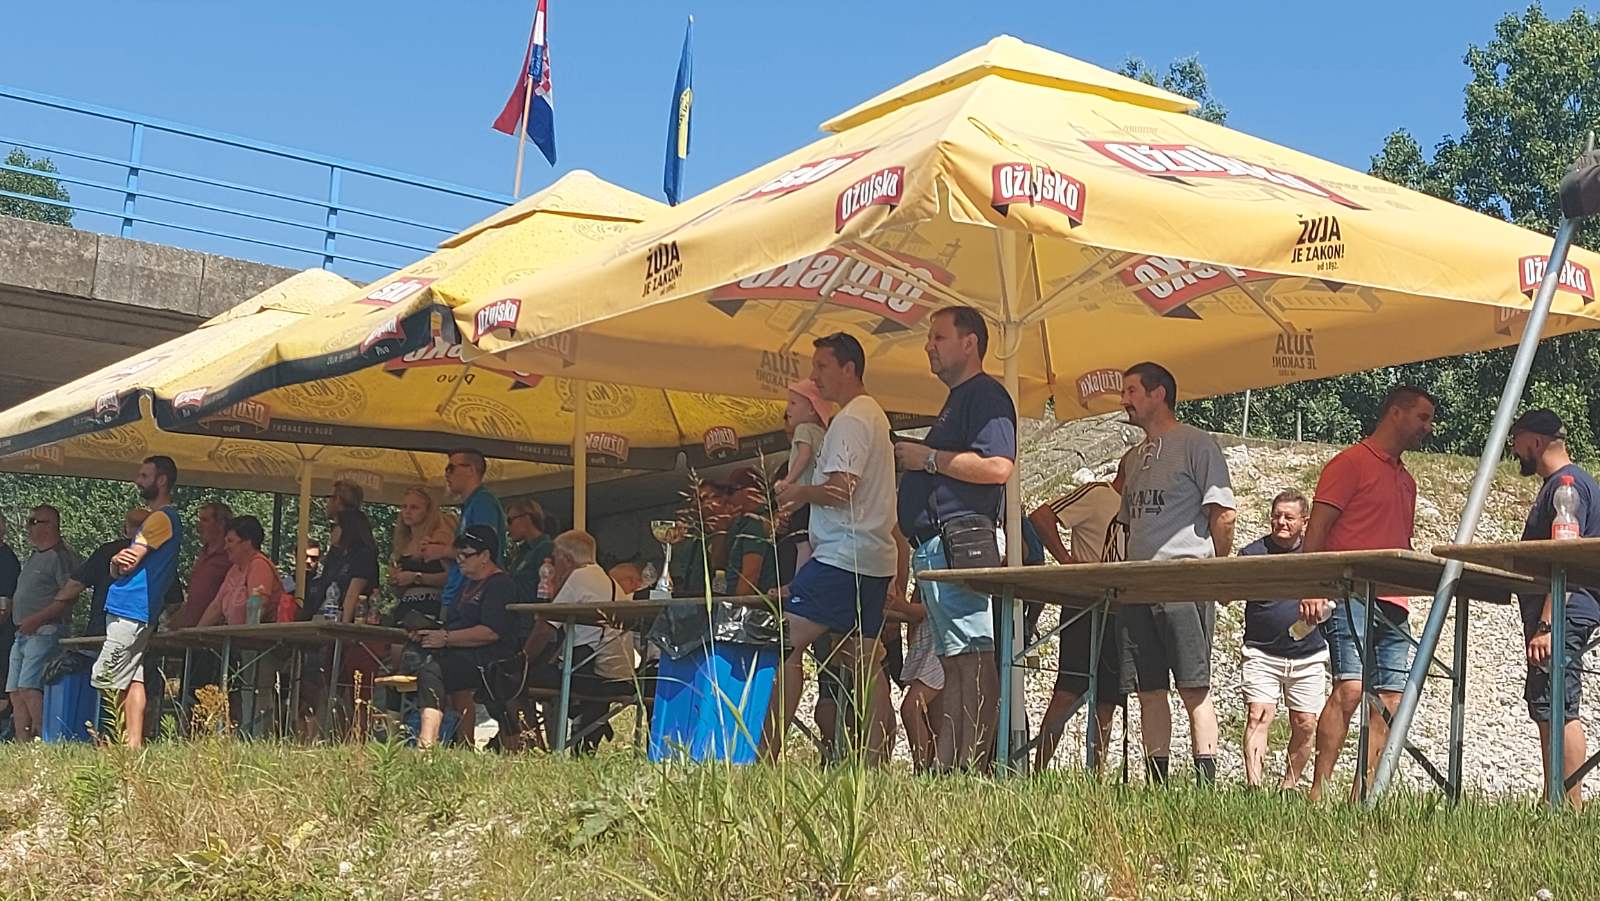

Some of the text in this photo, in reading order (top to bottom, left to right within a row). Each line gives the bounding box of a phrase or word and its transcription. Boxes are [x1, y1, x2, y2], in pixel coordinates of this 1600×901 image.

[1296, 213, 1341, 245] ŽUJA
[646, 240, 680, 280] ŽUJA
[1291, 244, 1345, 264] JE ZAKON!
